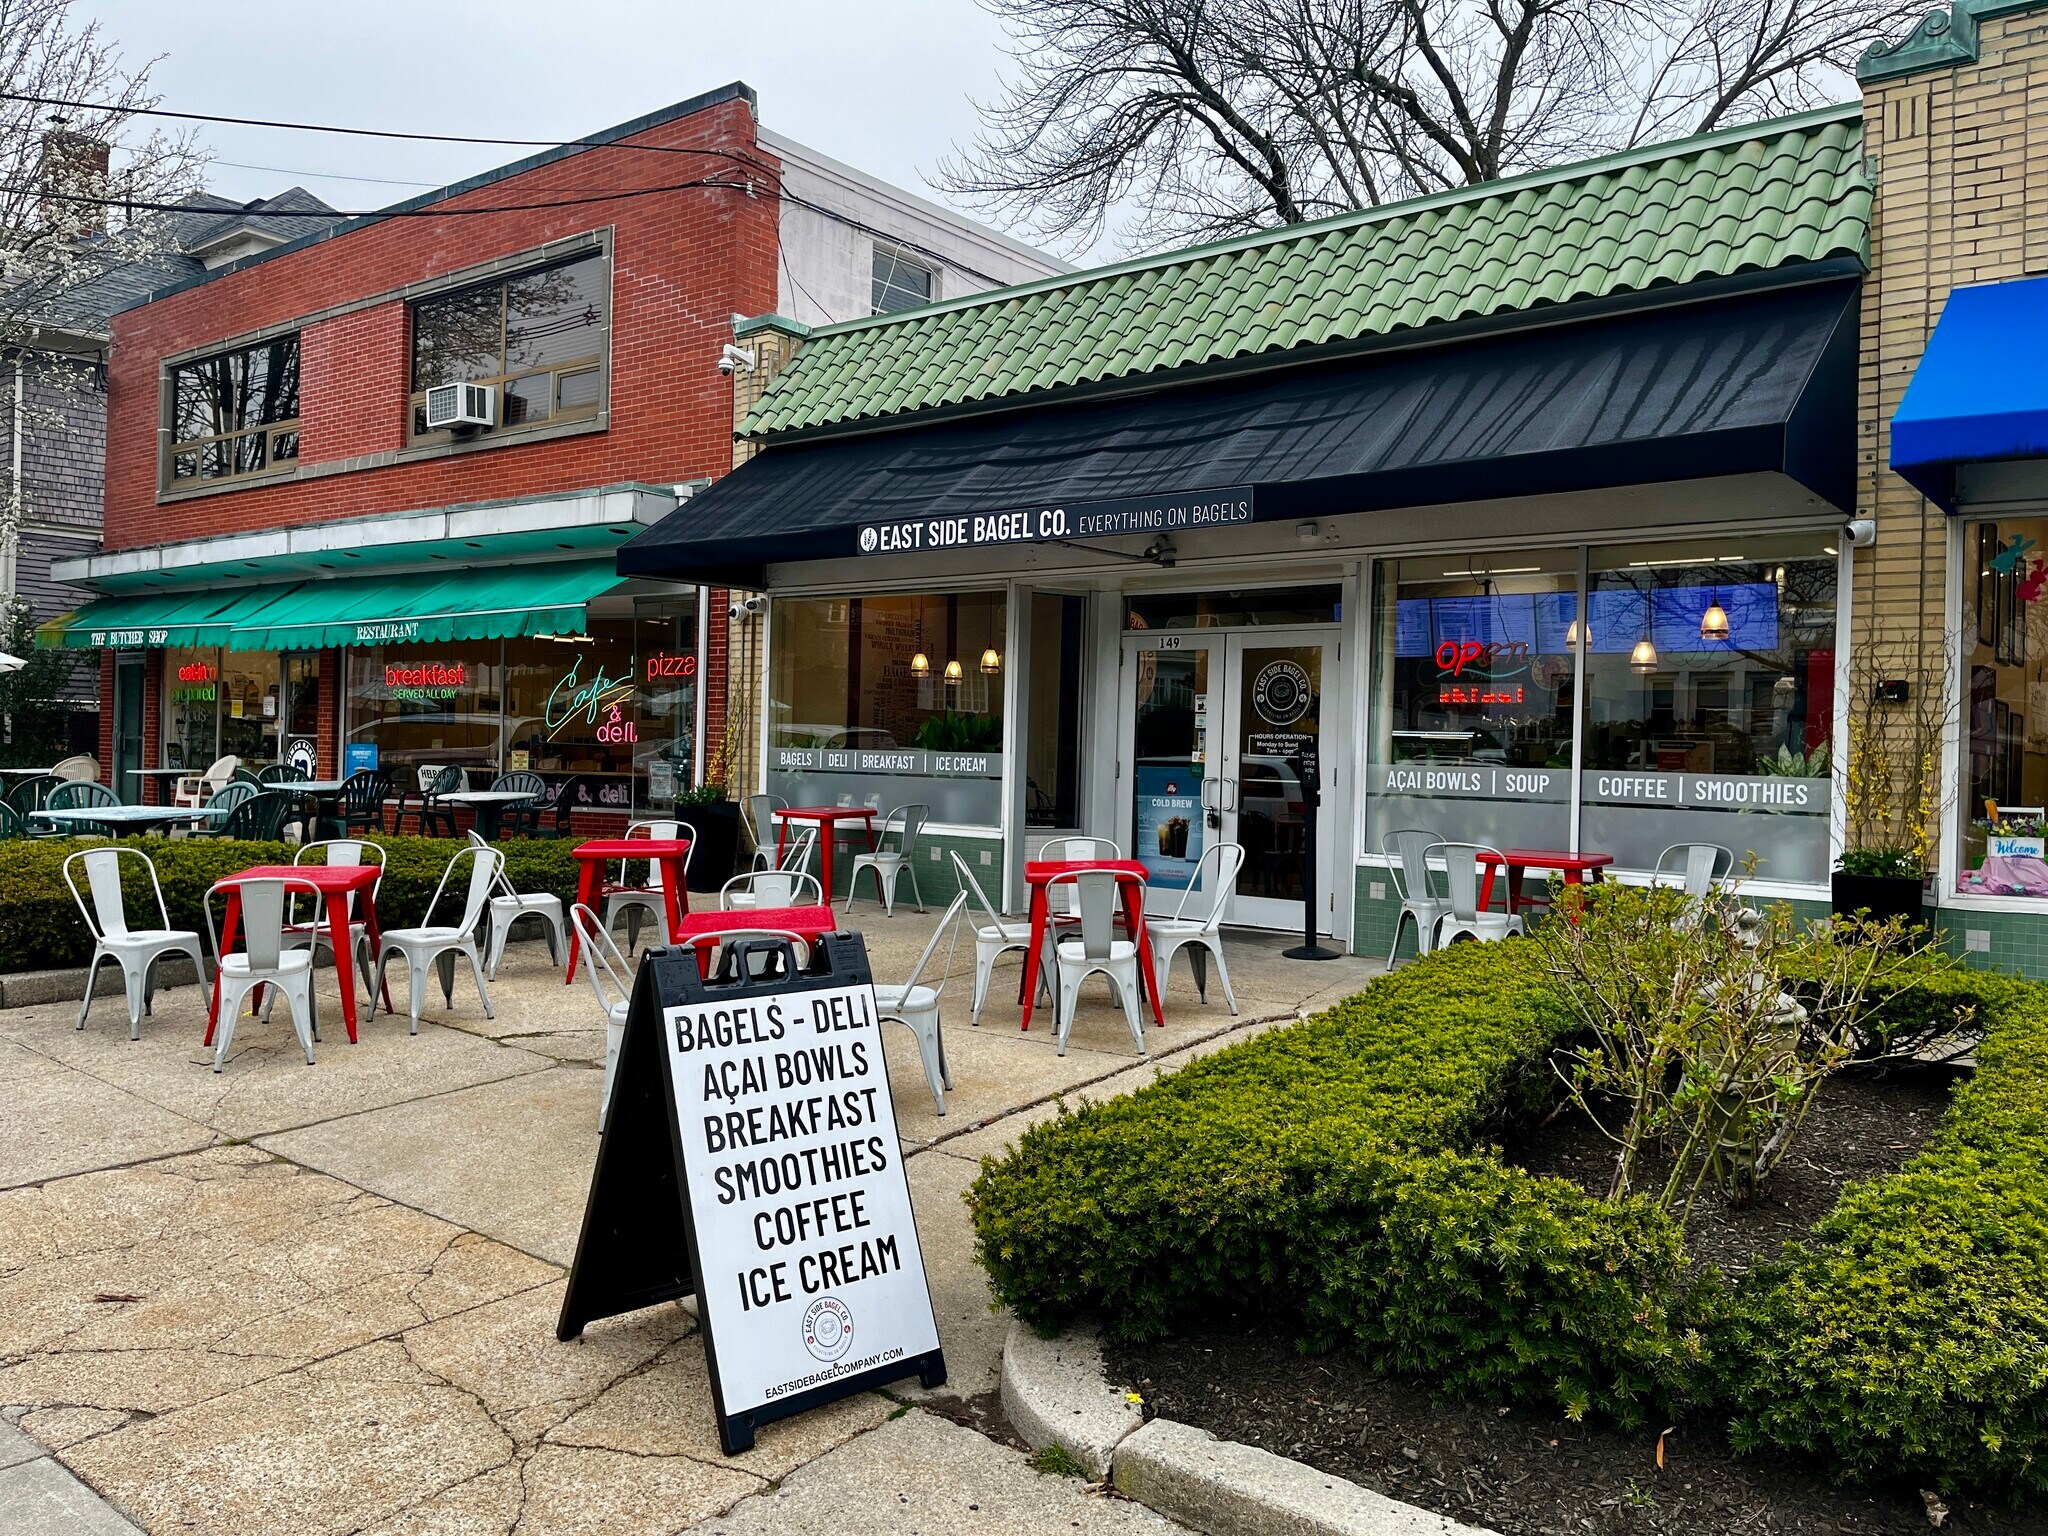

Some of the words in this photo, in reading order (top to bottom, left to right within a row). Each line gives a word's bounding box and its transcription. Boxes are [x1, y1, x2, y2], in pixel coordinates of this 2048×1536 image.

[879, 523, 923, 550] EAST
[928, 519, 968, 548] SIDE
[973, 513, 1033, 542] BAGEL
[1039, 510, 1071, 537] CO.
[1079, 509, 1162, 534] EVERYTHING
[1167, 508, 1186, 526] ON
[1192, 501, 1248, 523] BAGELS
[91, 632, 106, 646] THE
[110, 631, 144, 645] BUTCHER
[148, 630, 168, 644] SHOP
[356, 622, 419, 640] RESTAURANT
[1160, 637, 1180, 649] 149
[385, 664, 464, 686] breakfast
[647, 651, 696, 682] pizza
[1257, 674, 1269, 692] EAST
[1267, 664, 1282, 677] SIDE
[1282, 664, 1302, 682] BAGEL
[1298, 679, 1307, 692] CO.
[171, 683, 216, 705] prepared
[392, 689, 425, 699] SERVED
[426, 689, 441, 699] ALL
[441, 689, 457, 699] DAY
[609, 705, 622, 721] &
[1256, 741, 1278, 749] Monday
[420, 768, 438, 779] HELP
[780, 752, 812, 766] BAGELS
[828, 753, 848, 768] DELI
[862, 754, 915, 770] BREAKFAST
[935, 756, 951, 771] ICE
[953, 757, 987, 773] CREAM
[1386, 770, 1422, 792] AÇAI
[1425, 772, 1482, 792] BOWLS
[1505, 774, 1551, 794] SOUP
[1598, 777, 1668, 799] COFFEE
[1694, 780, 1809, 805] SMOOTHIES
[577, 784, 593, 803] &
[599, 784, 630, 804] deli
[1151, 798, 1170, 807] COLD
[1171, 799, 1193, 809] BREW
[1994, 839, 2039, 854] Welcome
[675, 1002, 785, 1053] BAGELS
[812, 993, 871, 1034] DELI
[702, 1058, 769, 1106] AÇAI
[775, 1041, 870, 1089] BOWLS
[703, 1087, 878, 1154] BREAKFAST
[713, 1136, 888, 1205] SMOOTHIES
[753, 1190, 871, 1251] COFFEE
[737, 1261, 792, 1312] ICE
[799, 1234, 901, 1295] CREAM
[805, 1315, 814, 1334] EAST
[810, 1302, 824, 1316] SIDE
[824, 1300, 841, 1314] BAGEL
[840, 1310, 849, 1323] CO.
[764, 1347, 905, 1399] EASTSIDEBAGELCOMPANY.COM
